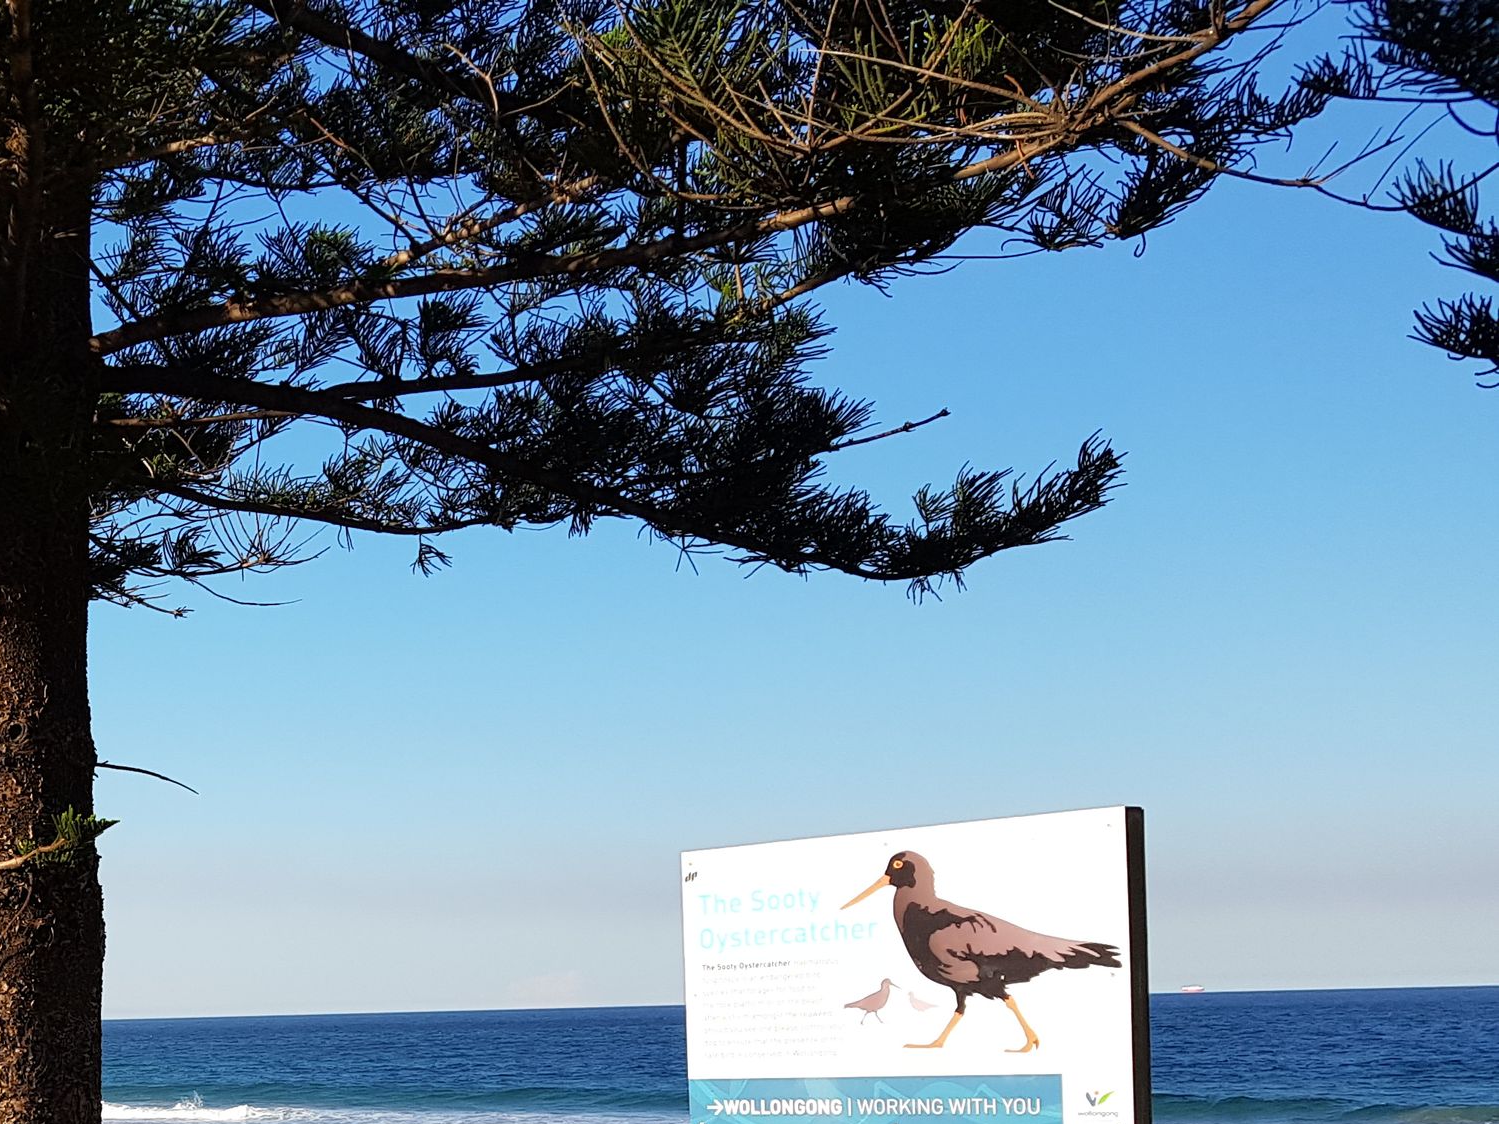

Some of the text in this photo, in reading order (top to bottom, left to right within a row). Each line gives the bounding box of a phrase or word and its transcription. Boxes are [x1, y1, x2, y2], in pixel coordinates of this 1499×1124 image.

[698, 888, 821, 914] The Sooty
[699, 919, 878, 954] Oystercatcher
[702, 963, 715, 971] The
[717, 962, 737, 972] Sooty
[739, 959, 791, 971] Oystercatcher
[723, 1099, 843, 1116] WOLLONGONG
[857, 1098, 944, 1116] WORKING
[948, 1098, 997, 1116] WITH
[1002, 1098, 1041, 1115] YOU
[1077, 1110, 1119, 1118] wollongong
